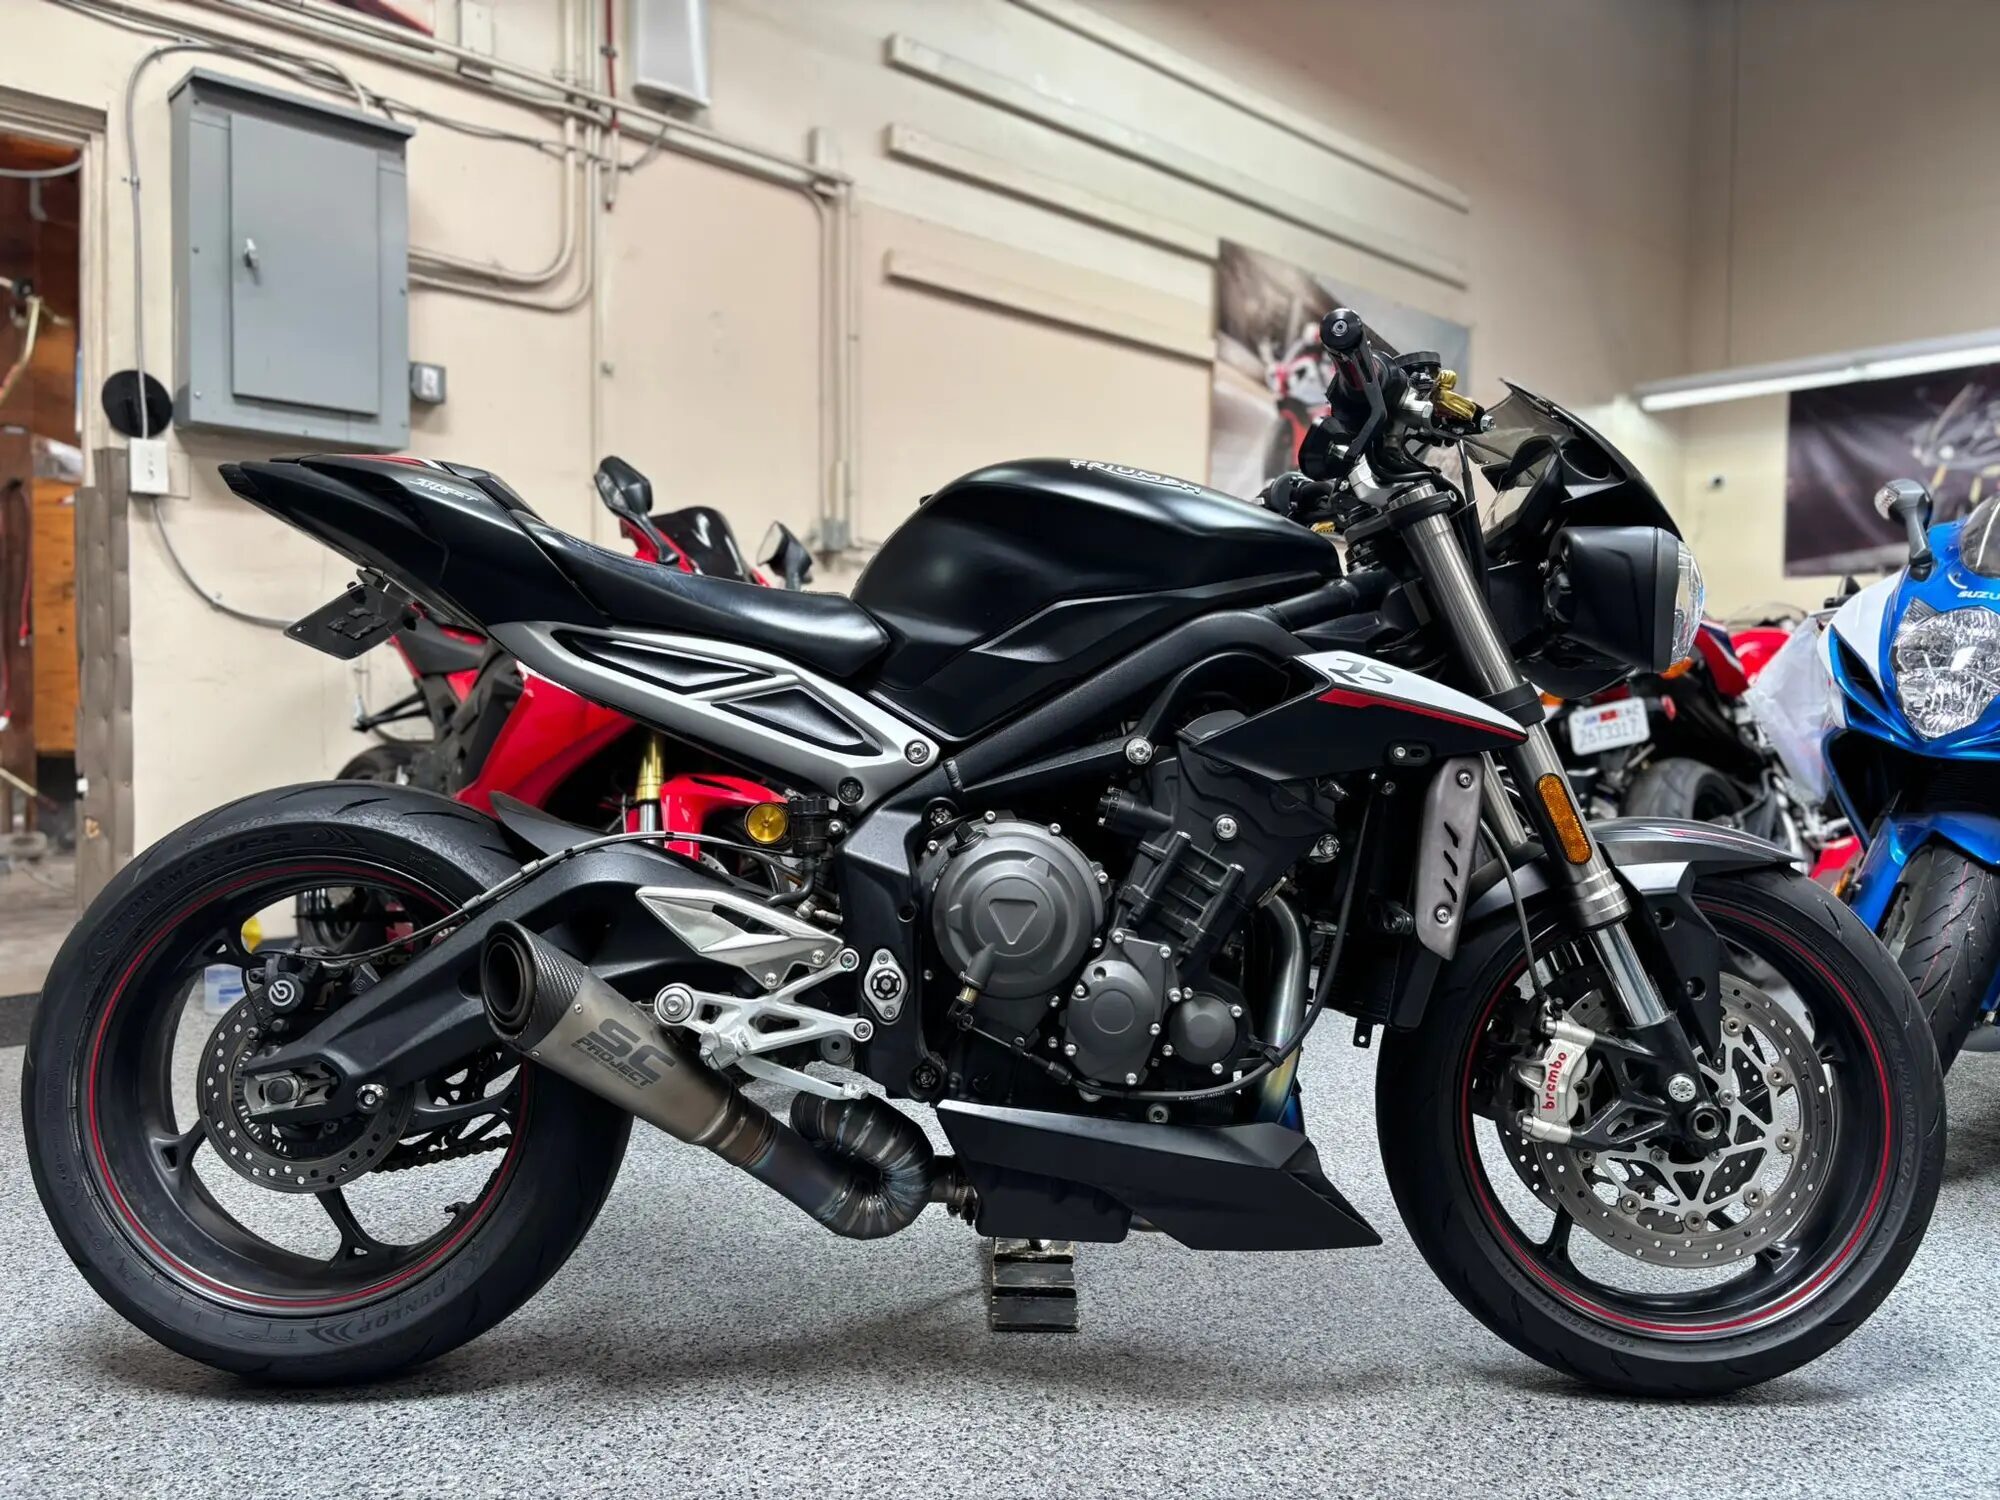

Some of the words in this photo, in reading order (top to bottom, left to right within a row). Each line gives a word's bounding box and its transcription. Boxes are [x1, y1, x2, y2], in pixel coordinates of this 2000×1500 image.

[1069, 459, 1201, 495] TRIUMPH
[1328, 658, 1401, 685] RS
[571, 1036, 654, 1087] PROJECT
[586, 1018, 677, 1081] SC
[1542, 1052, 1567, 1109] brembo
[357, 1279, 446, 1334] DUNLOP
